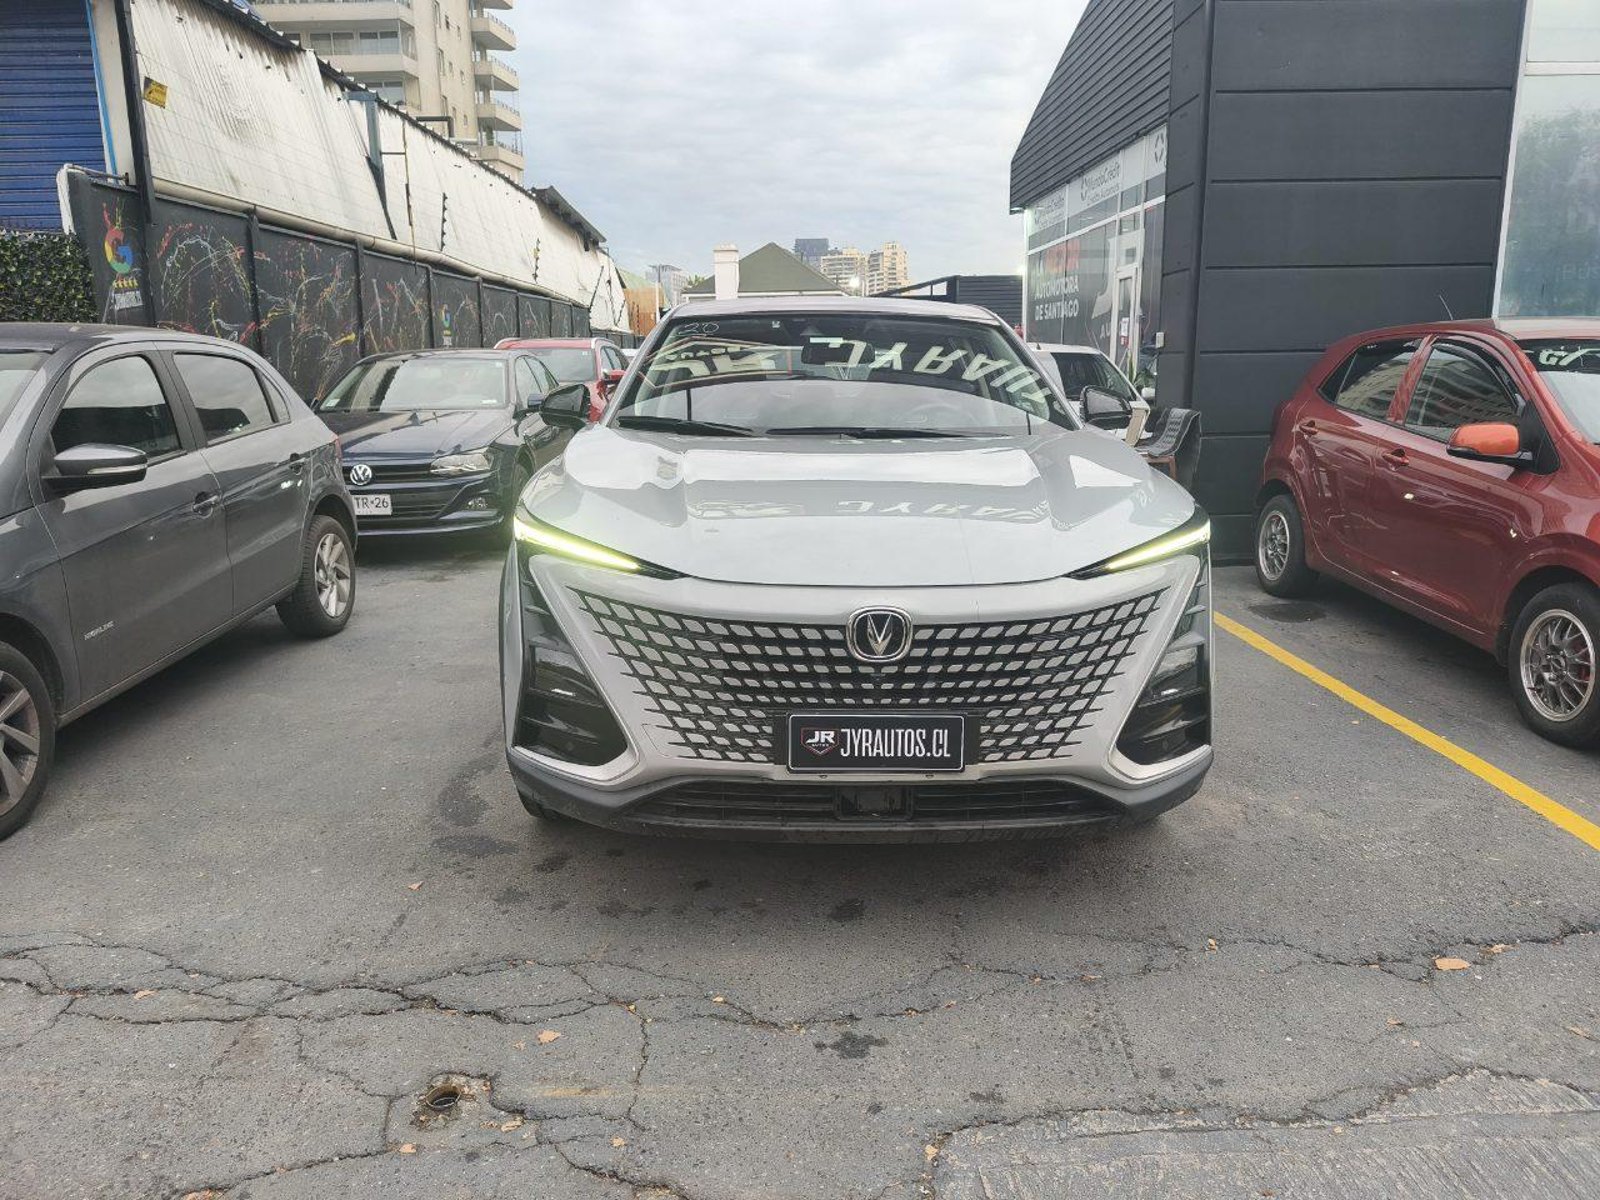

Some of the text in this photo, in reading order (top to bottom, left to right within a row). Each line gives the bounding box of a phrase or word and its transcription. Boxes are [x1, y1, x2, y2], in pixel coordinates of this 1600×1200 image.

[1034, 298, 1079, 321] DE SANTIAGO
[805, 728, 951, 758] JR JYRAUTOS.CL
